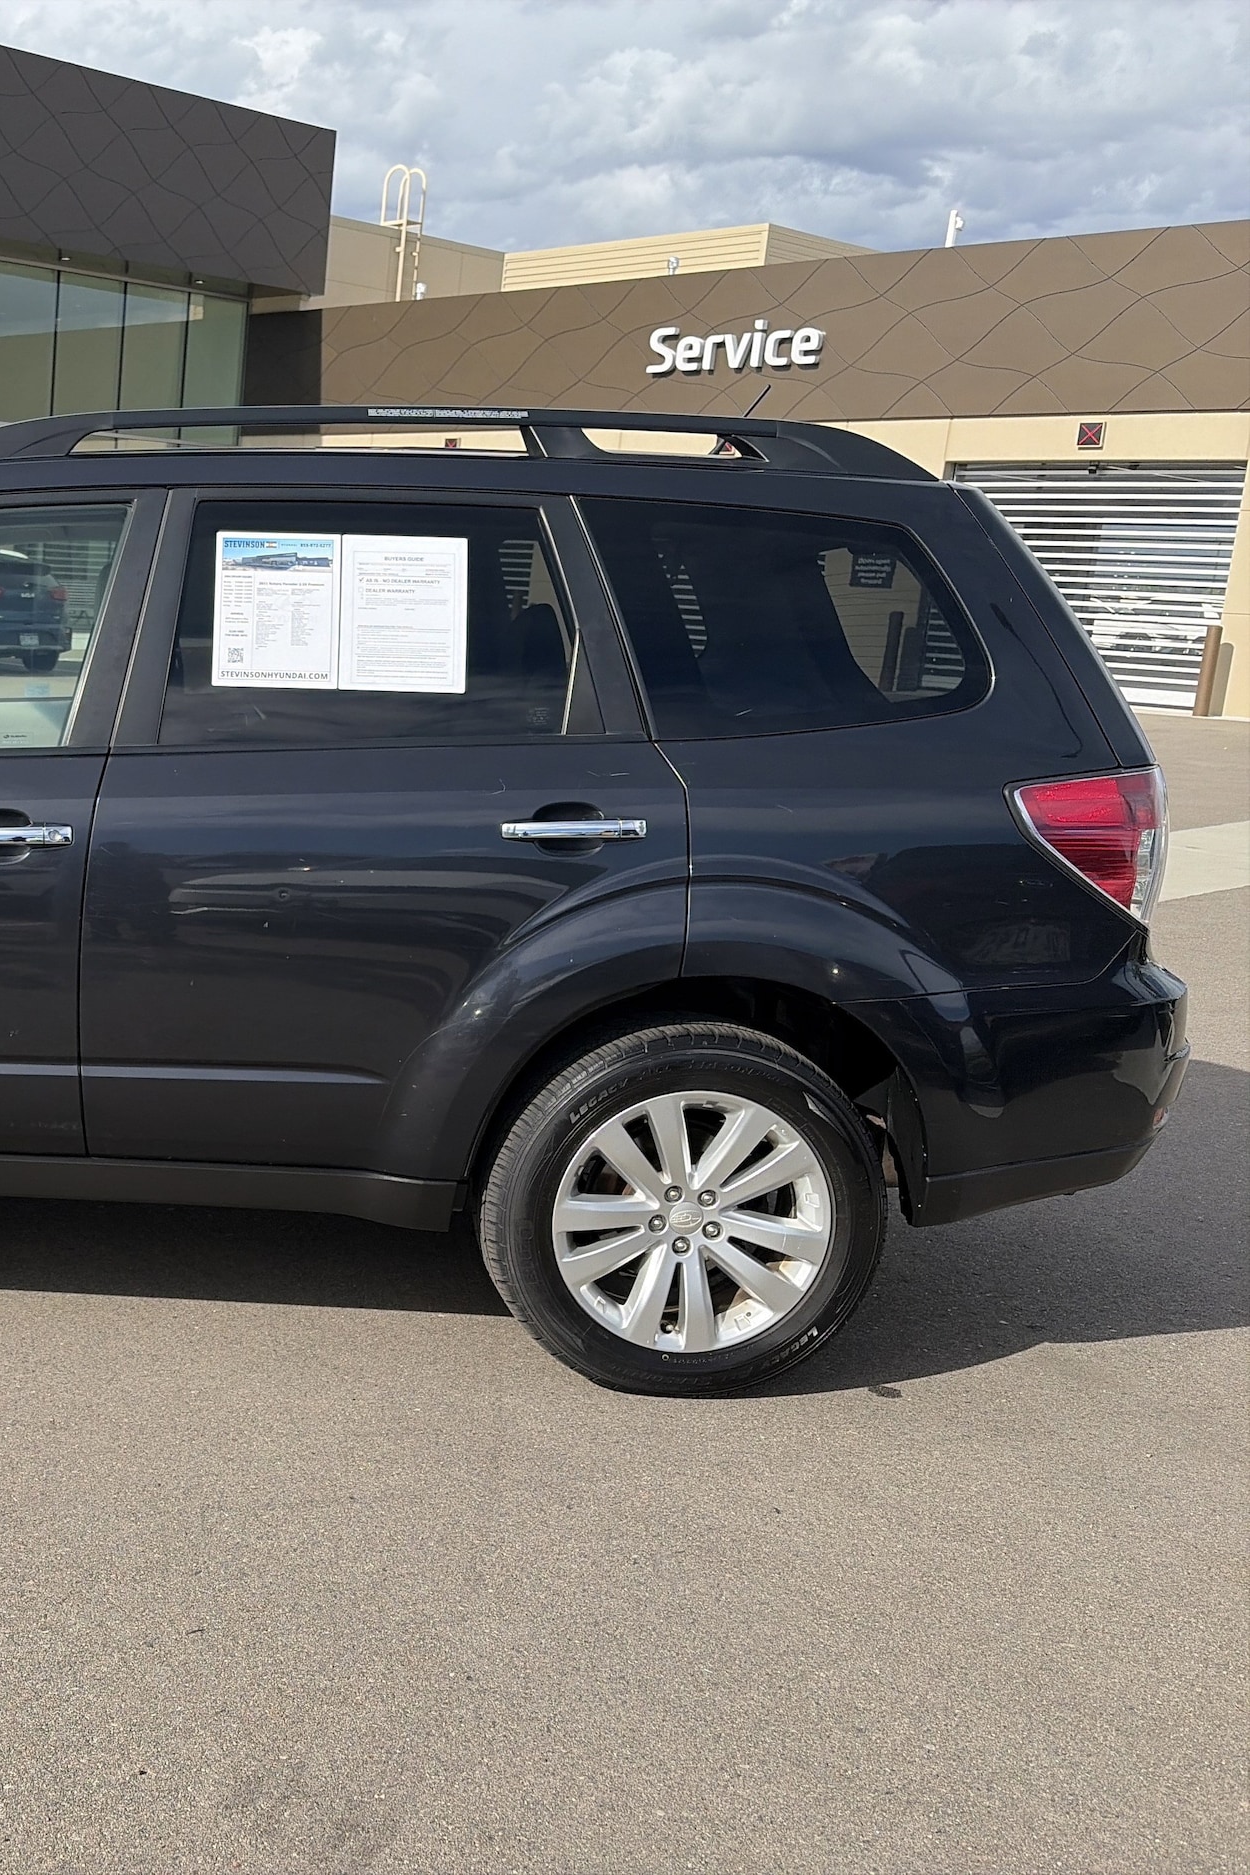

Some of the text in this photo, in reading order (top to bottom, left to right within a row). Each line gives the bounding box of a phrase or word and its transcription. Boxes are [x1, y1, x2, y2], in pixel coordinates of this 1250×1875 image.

[646, 319, 823, 374] Service
[224, 540, 265, 549] STEVINSON
[220, 670, 328, 680] STEVINSONHYUNDAI.COM
[569, 1078, 628, 1124] LEGACY
[765, 1326, 818, 1366] LEGAC
